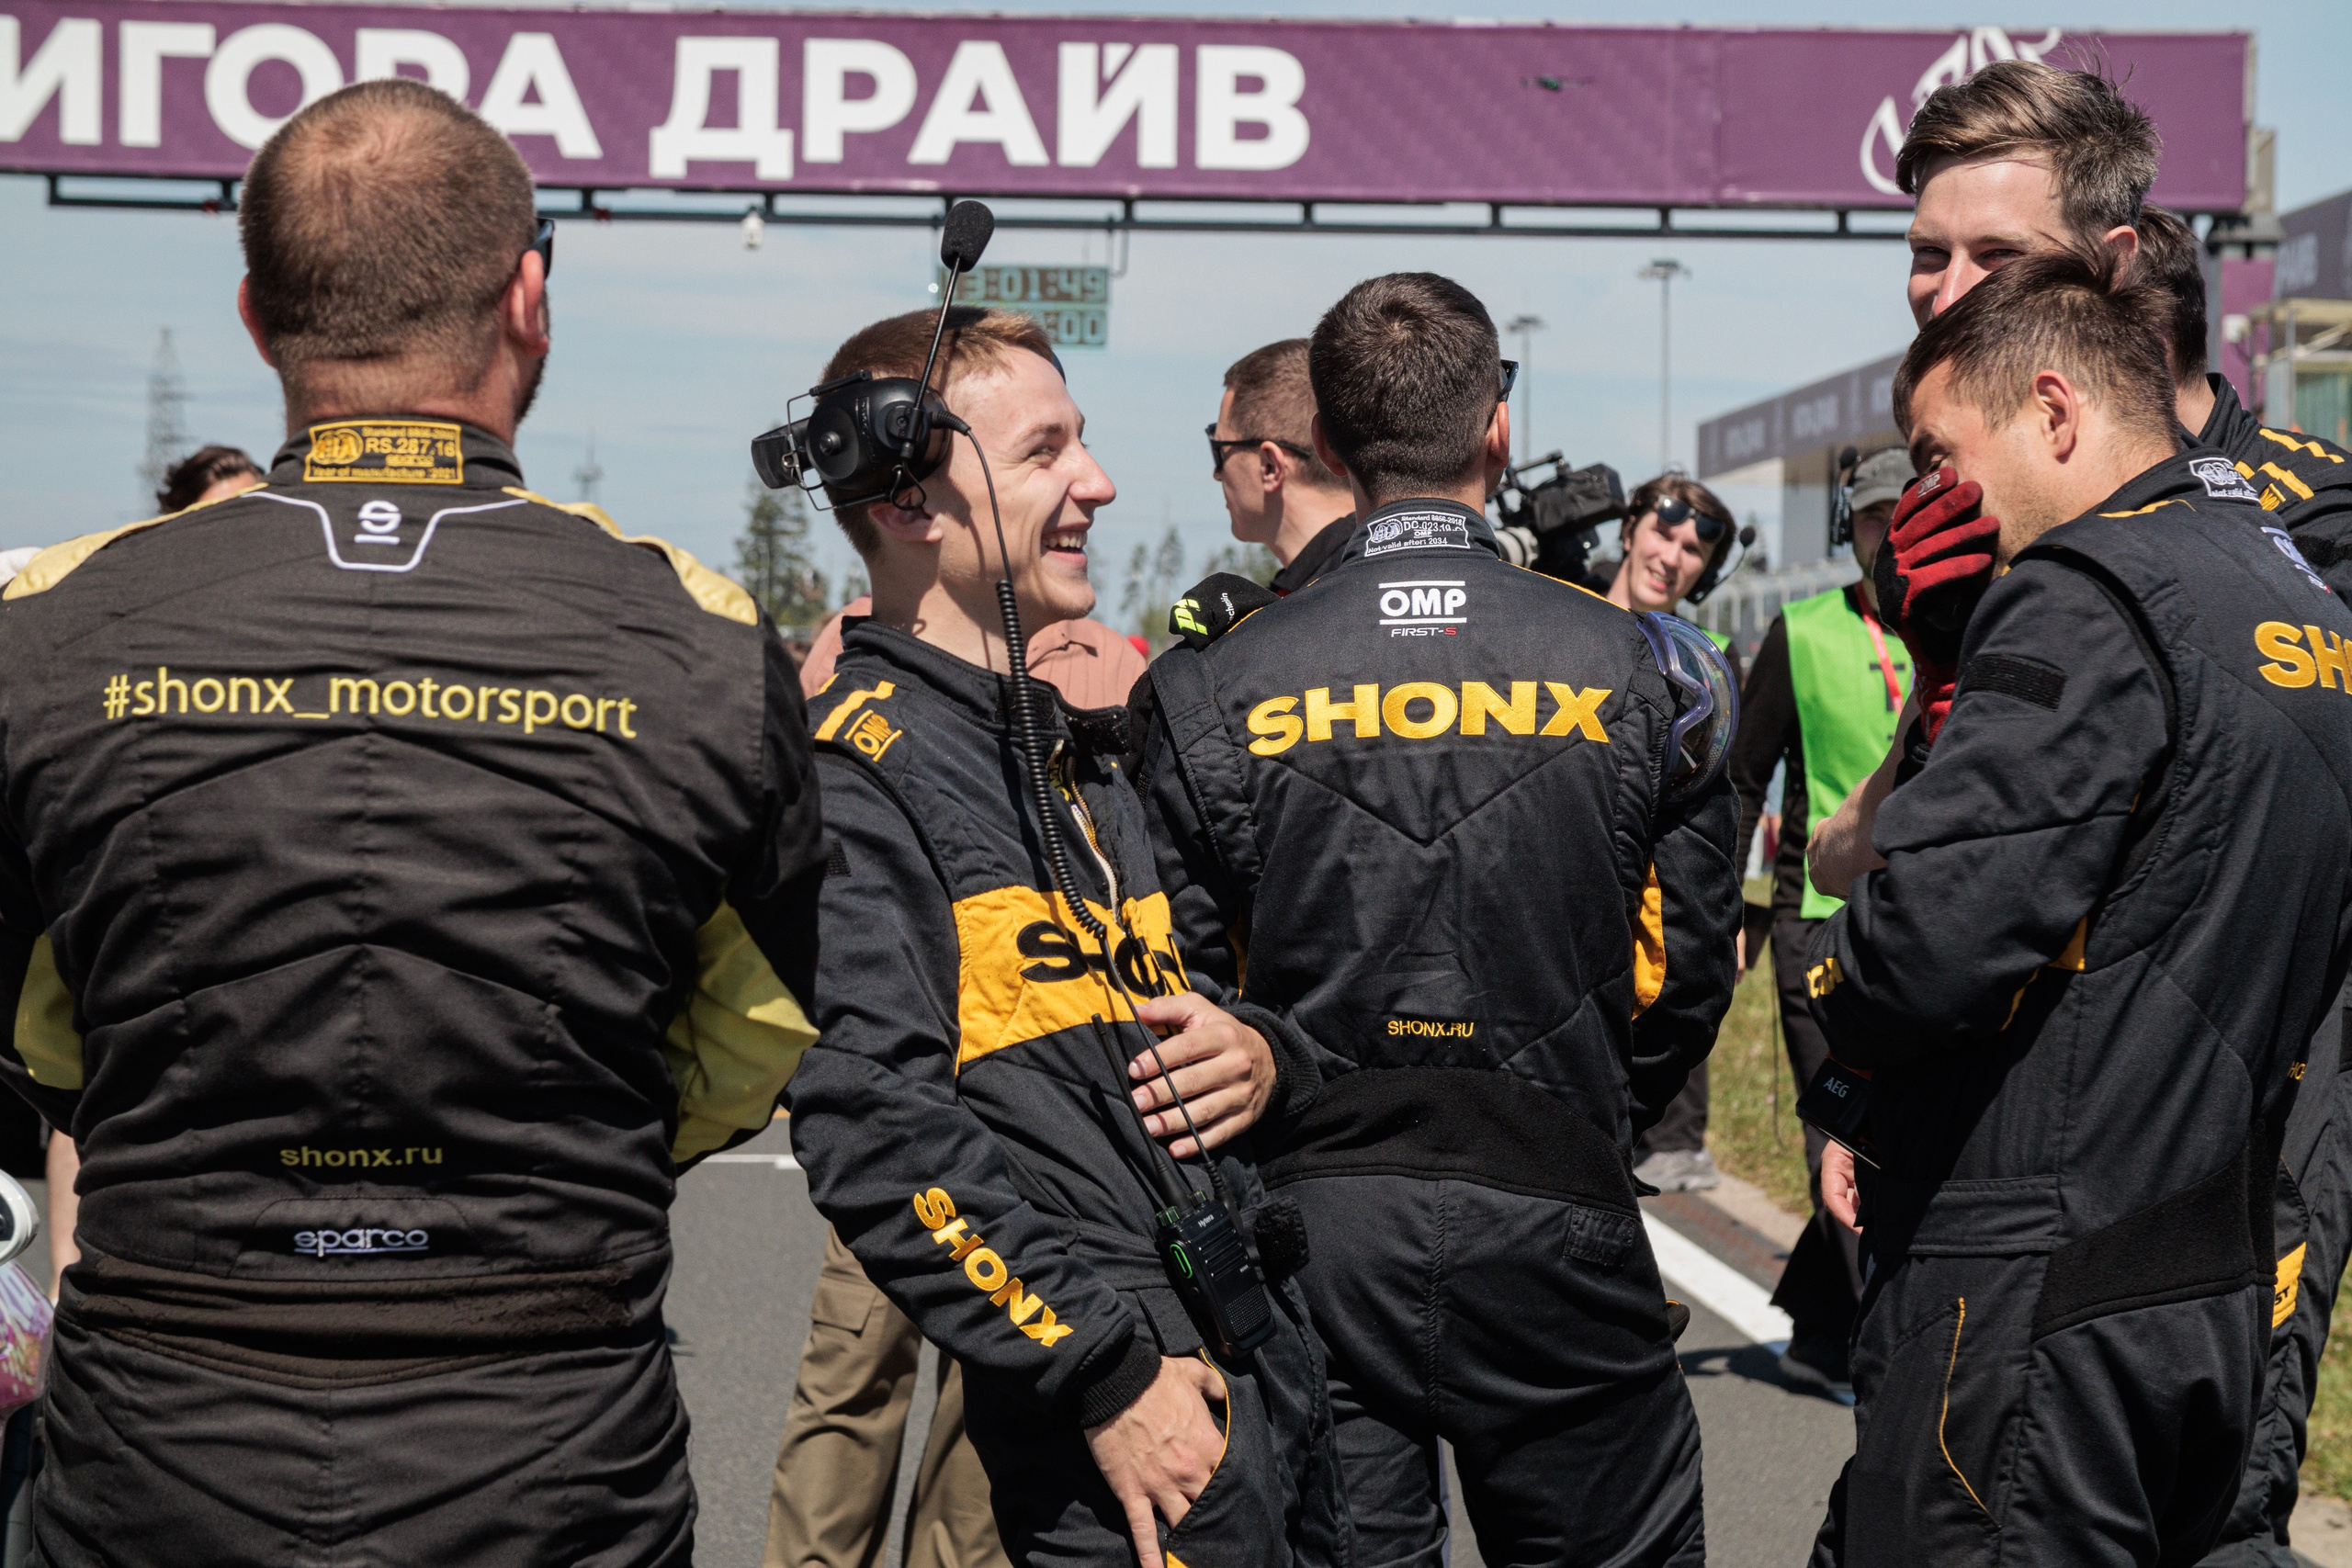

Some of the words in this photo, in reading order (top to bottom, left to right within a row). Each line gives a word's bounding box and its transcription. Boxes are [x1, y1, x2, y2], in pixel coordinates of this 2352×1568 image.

[648, 36, 1311, 182] ДРАЙВ
[365, 437, 456, 457] RS.287.16
[1428, 536, 1448, 545] 2034
[1379, 587, 1467, 617] OMP
[1390, 626, 1458, 637] FIRST-S
[102, 666, 638, 739] #shonx_motorsport
[1246, 681, 1613, 757] SHONX
[1387, 1020, 1475, 1038] SHONX.RU
[1823, 1077, 1850, 1099] AEG
[279, 1145, 444, 1168] shonx.ru
[1197, 1213, 1215, 1228] Hytera
[293, 1228, 430, 1258] sparco
[912, 1186, 1075, 1348] SHONX
